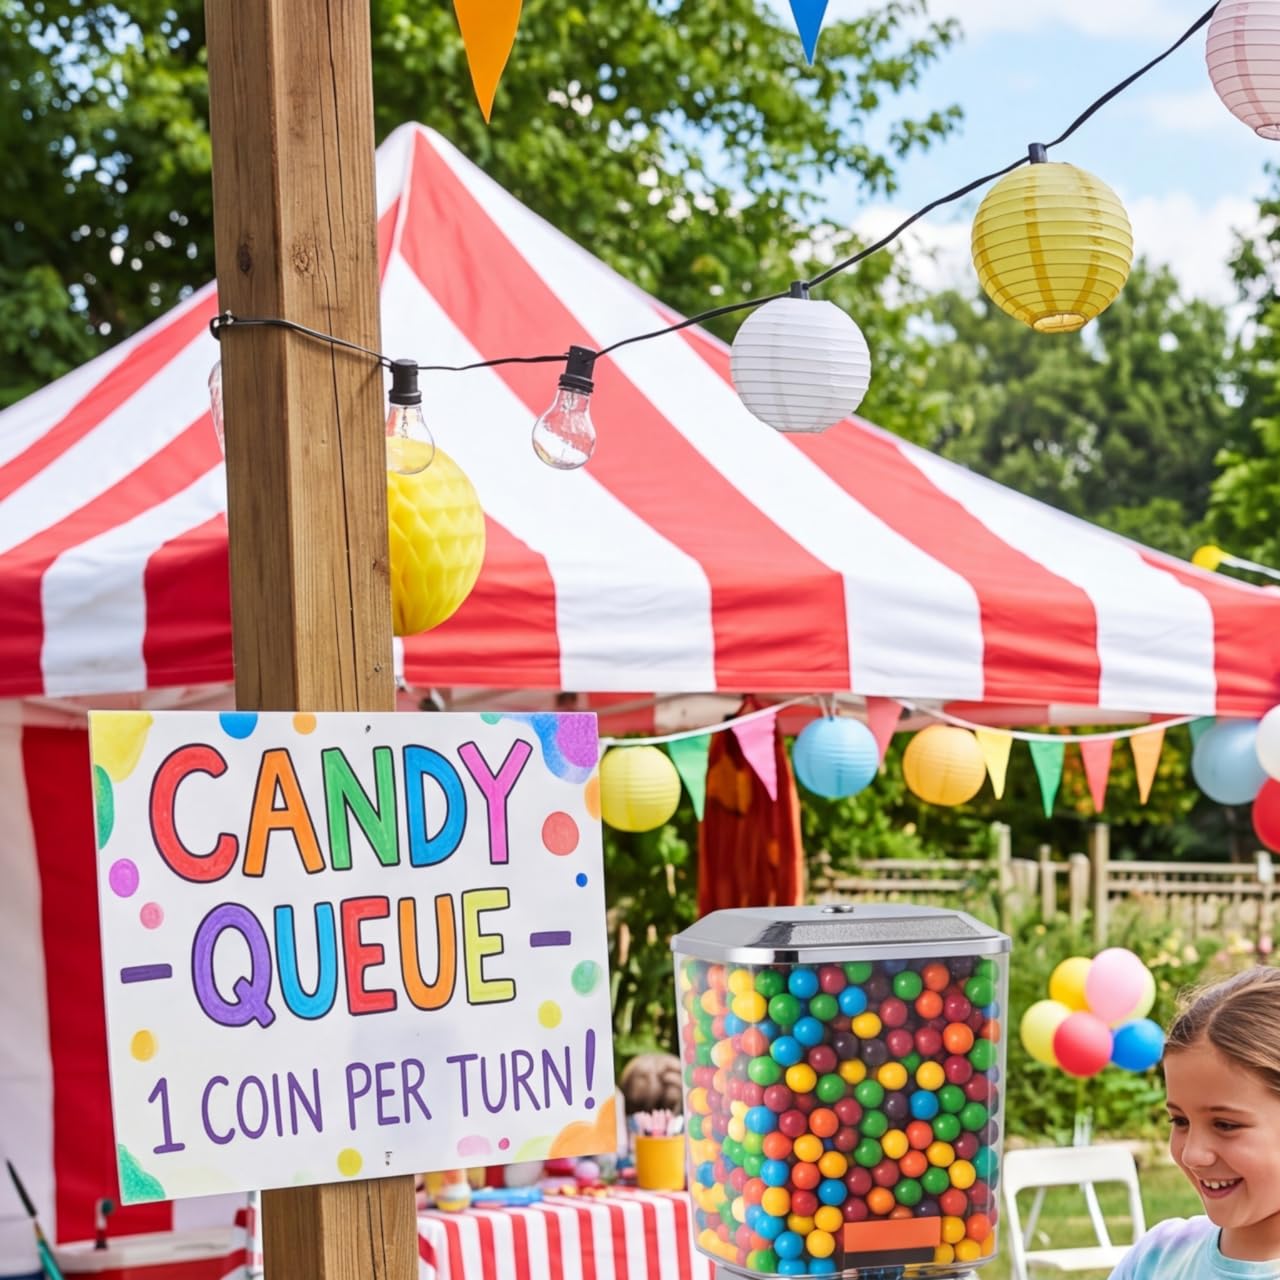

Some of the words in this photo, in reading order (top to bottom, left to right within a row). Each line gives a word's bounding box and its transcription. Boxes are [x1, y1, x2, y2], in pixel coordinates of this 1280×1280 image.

[149, 739, 533, 884] CANDY
[148, 1078, 186, 1155] 1
[201, 1068, 323, 1145] COIN
[345, 1058, 432, 1131] PER
[446, 1029, 596, 1117] TURN!
